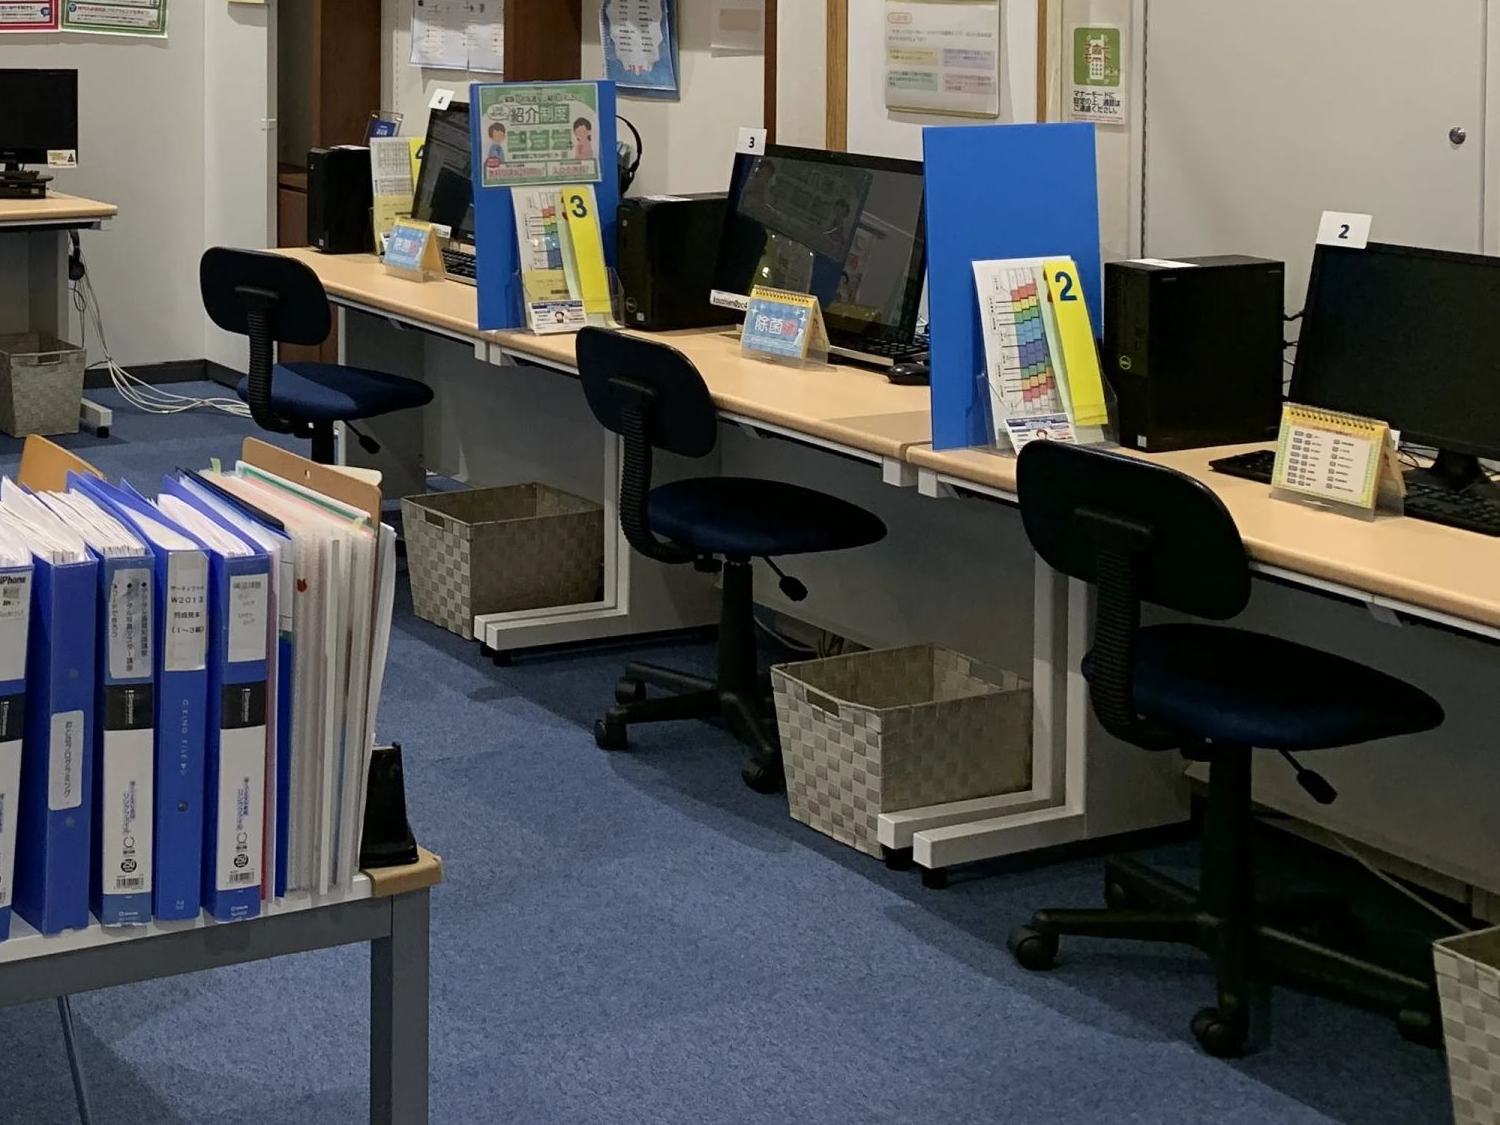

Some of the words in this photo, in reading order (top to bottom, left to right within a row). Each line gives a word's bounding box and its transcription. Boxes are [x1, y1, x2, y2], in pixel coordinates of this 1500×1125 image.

[437, 96, 444, 105] 4
[510, 107, 566, 124] 紹介制度
[748, 137, 755, 148] 3
[570, 195, 588, 218] 3
[1338, 224, 1350, 240] 2
[1055, 271, 1078, 301] 2
